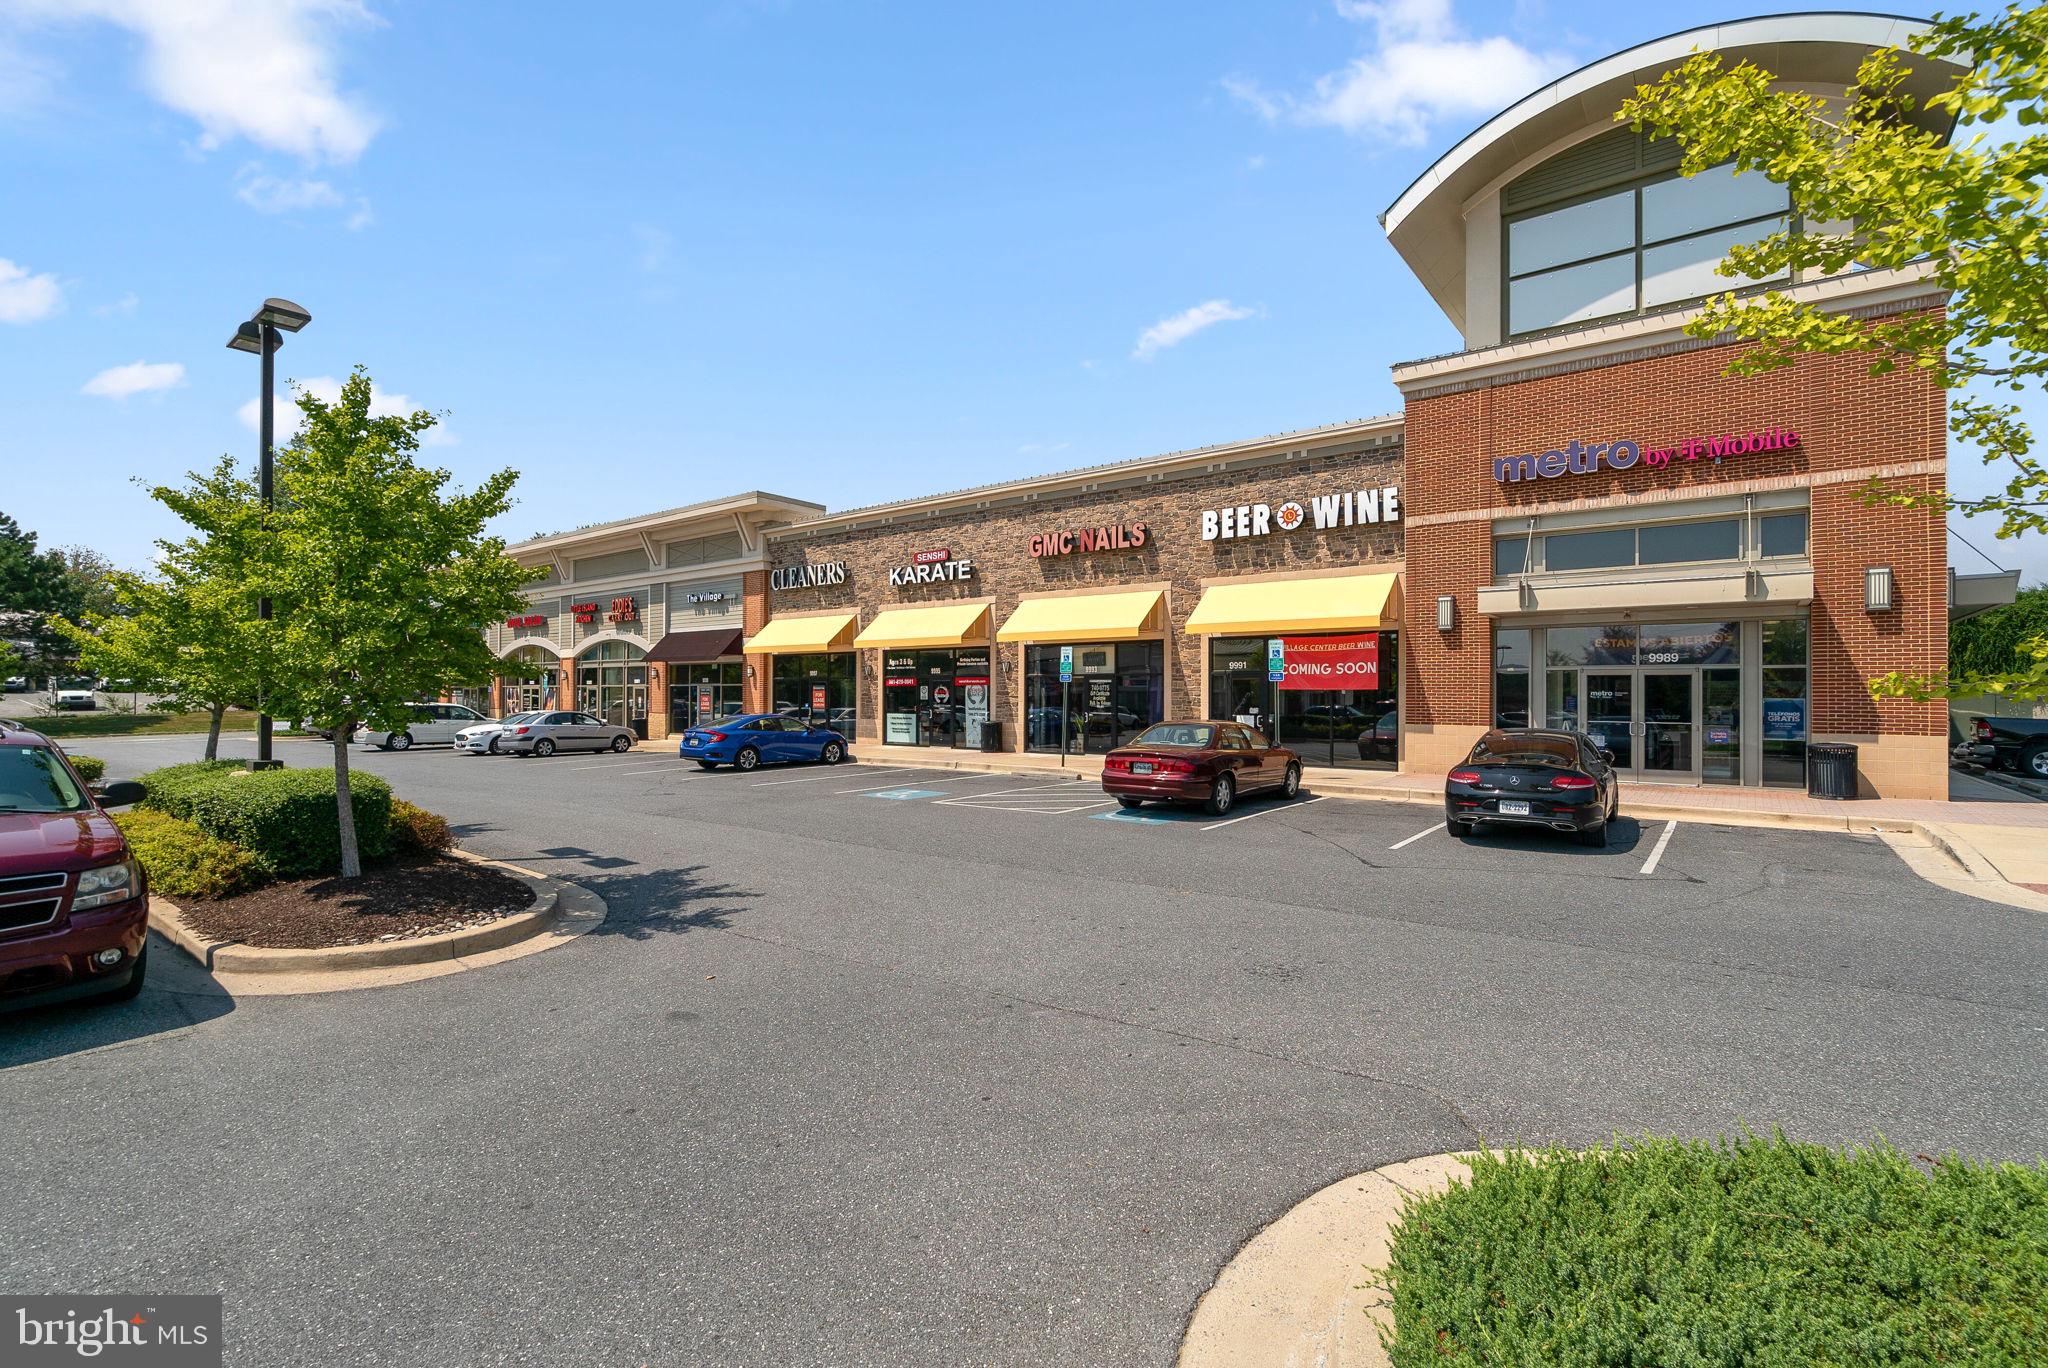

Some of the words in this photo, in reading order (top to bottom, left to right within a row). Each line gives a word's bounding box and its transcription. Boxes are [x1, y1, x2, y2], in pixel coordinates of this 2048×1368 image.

[1493, 439, 1640, 482] metro
[1644, 446, 1673, 469] by
[1202, 503, 1271, 540] BEER
[1311, 486, 1399, 530] WINE
[1029, 530, 1073, 558] GMC
[1079, 522, 1146, 553] NAILS
[917, 550, 946, 562] SENSHI
[771, 562, 845, 591] CLEANERS
[889, 560, 972, 586] KARATE
[686, 594, 698, 603] The
[699, 592, 722, 602] Village
[1338, 642, 1355, 650] BEER
[1357, 640, 1376, 648] WINE
[1648, 653, 1679, 662] 9989
[1229, 661, 1247, 670] 9991
[1335, 661, 1377, 675] SOON
